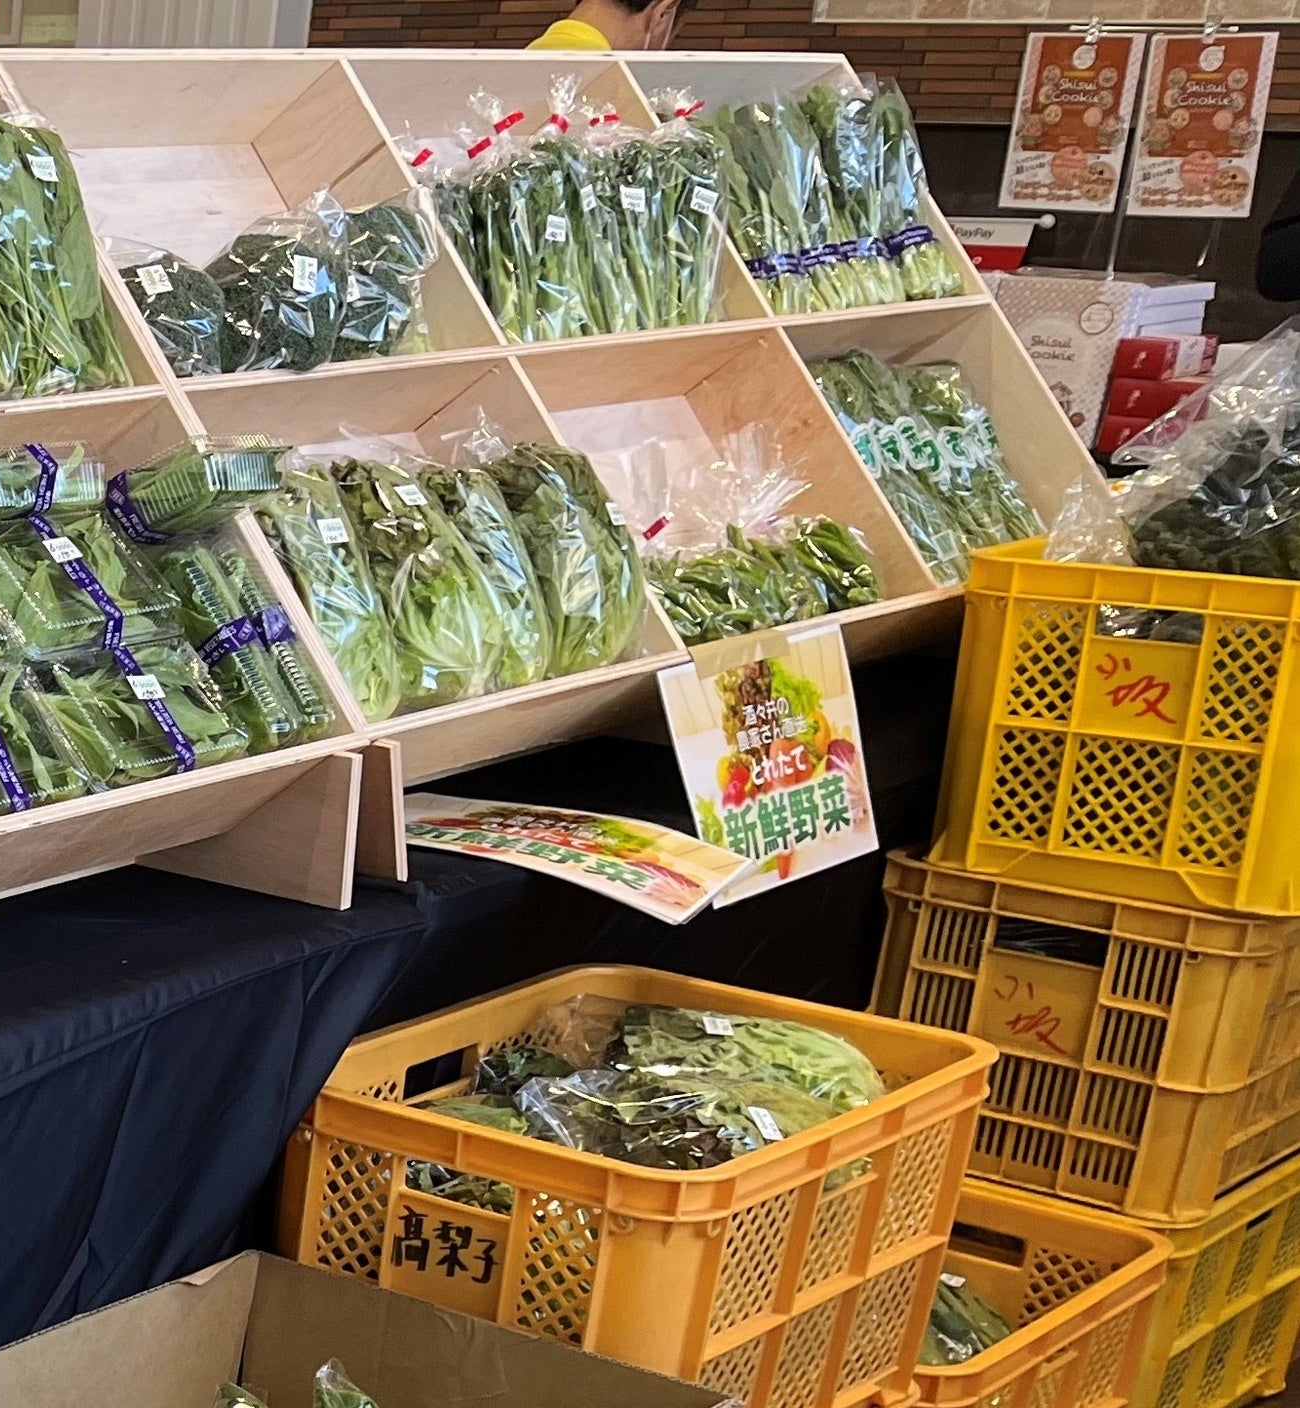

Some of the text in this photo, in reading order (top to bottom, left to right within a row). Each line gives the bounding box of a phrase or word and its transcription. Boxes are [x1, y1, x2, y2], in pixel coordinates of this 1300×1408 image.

[954, 226, 996, 240] PayPay
[742, 697, 790, 726] 酒々井の
[751, 745, 807, 786] とれたて
[723, 774, 851, 860] 新鮮野菜
